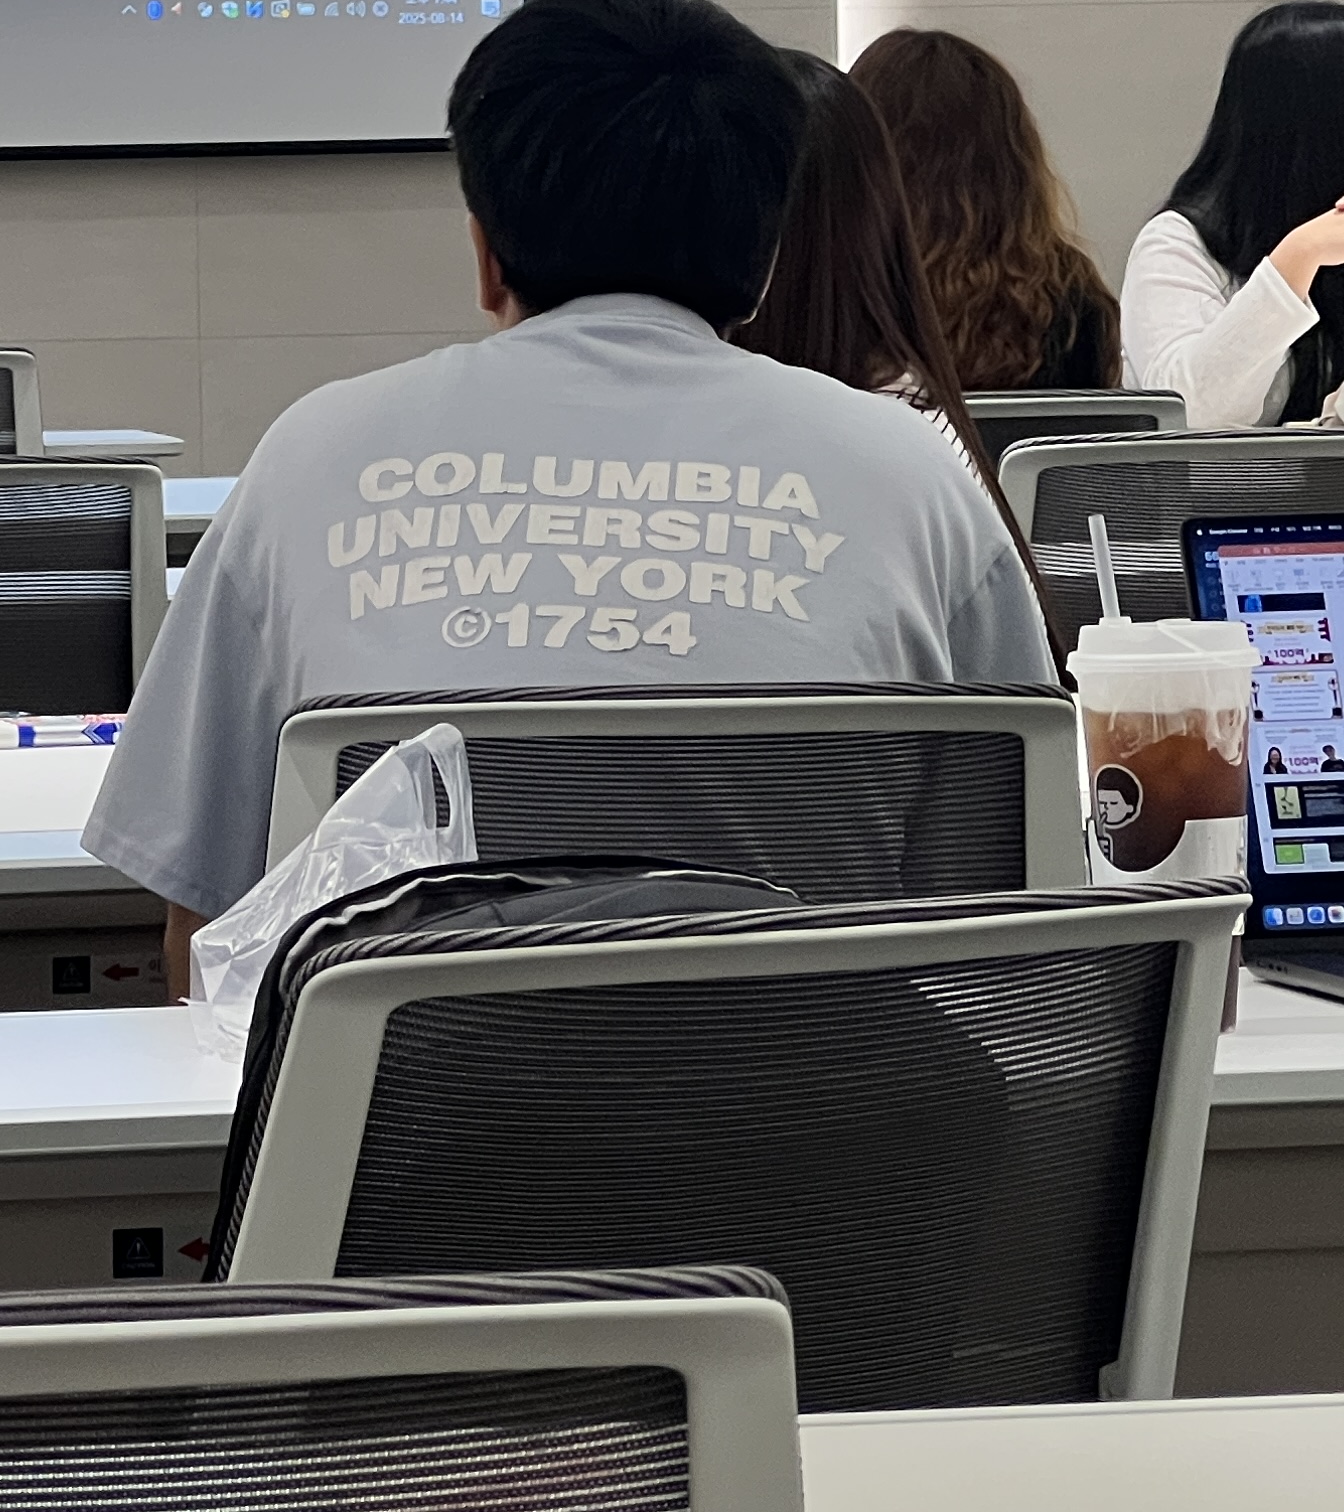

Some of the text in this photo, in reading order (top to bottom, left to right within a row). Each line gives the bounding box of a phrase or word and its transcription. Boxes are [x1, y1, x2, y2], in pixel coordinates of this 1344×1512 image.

[359, 451, 820, 520] COLUMBIA
[328, 503, 846, 574] UNIVERSITY
[350, 553, 811, 623] NEW YORK
